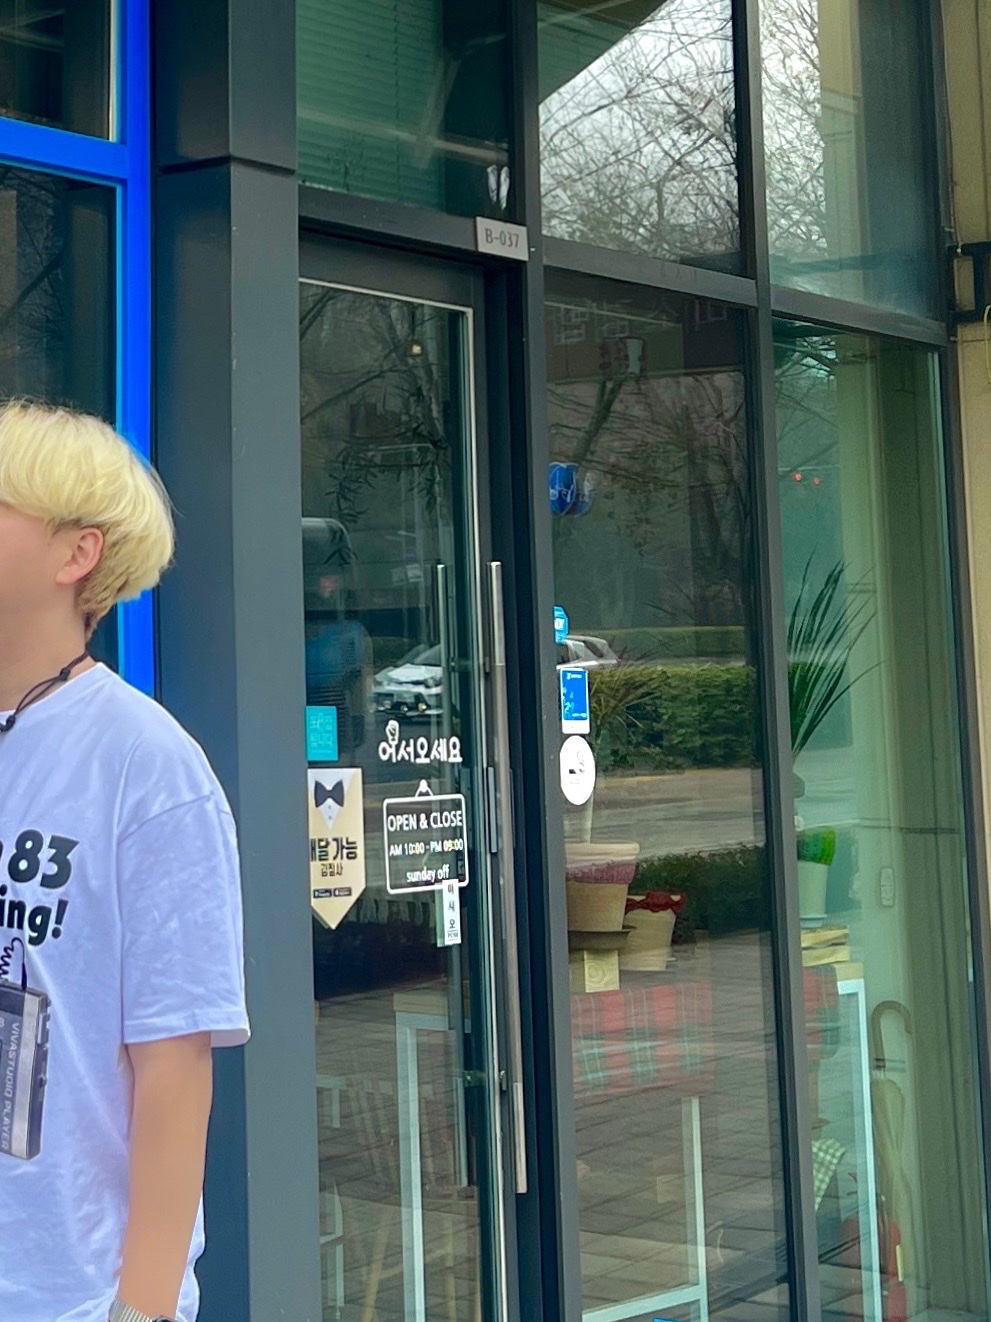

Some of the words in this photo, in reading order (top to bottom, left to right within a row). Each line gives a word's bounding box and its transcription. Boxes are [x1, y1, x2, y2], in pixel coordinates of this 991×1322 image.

[484, 228, 520, 249] B-037
[379, 735, 463, 763] 어서오세요
[387, 814, 417, 832] OPEN
[419, 813, 428, 830] &
[430, 811, 463, 829] CLOSE
[8, 829, 80, 889] 83
[389, 844, 403, 857] AM
[404, 842, 425, 856] 10:00
[430, 841, 441, 853] PM
[406, 866, 436, 883] sunday
[437, 864, 450, 879] off
[4, 1022, 20, 1098] VIVASTUDIO
[0, 1100, 12, 1151] PLAYER
